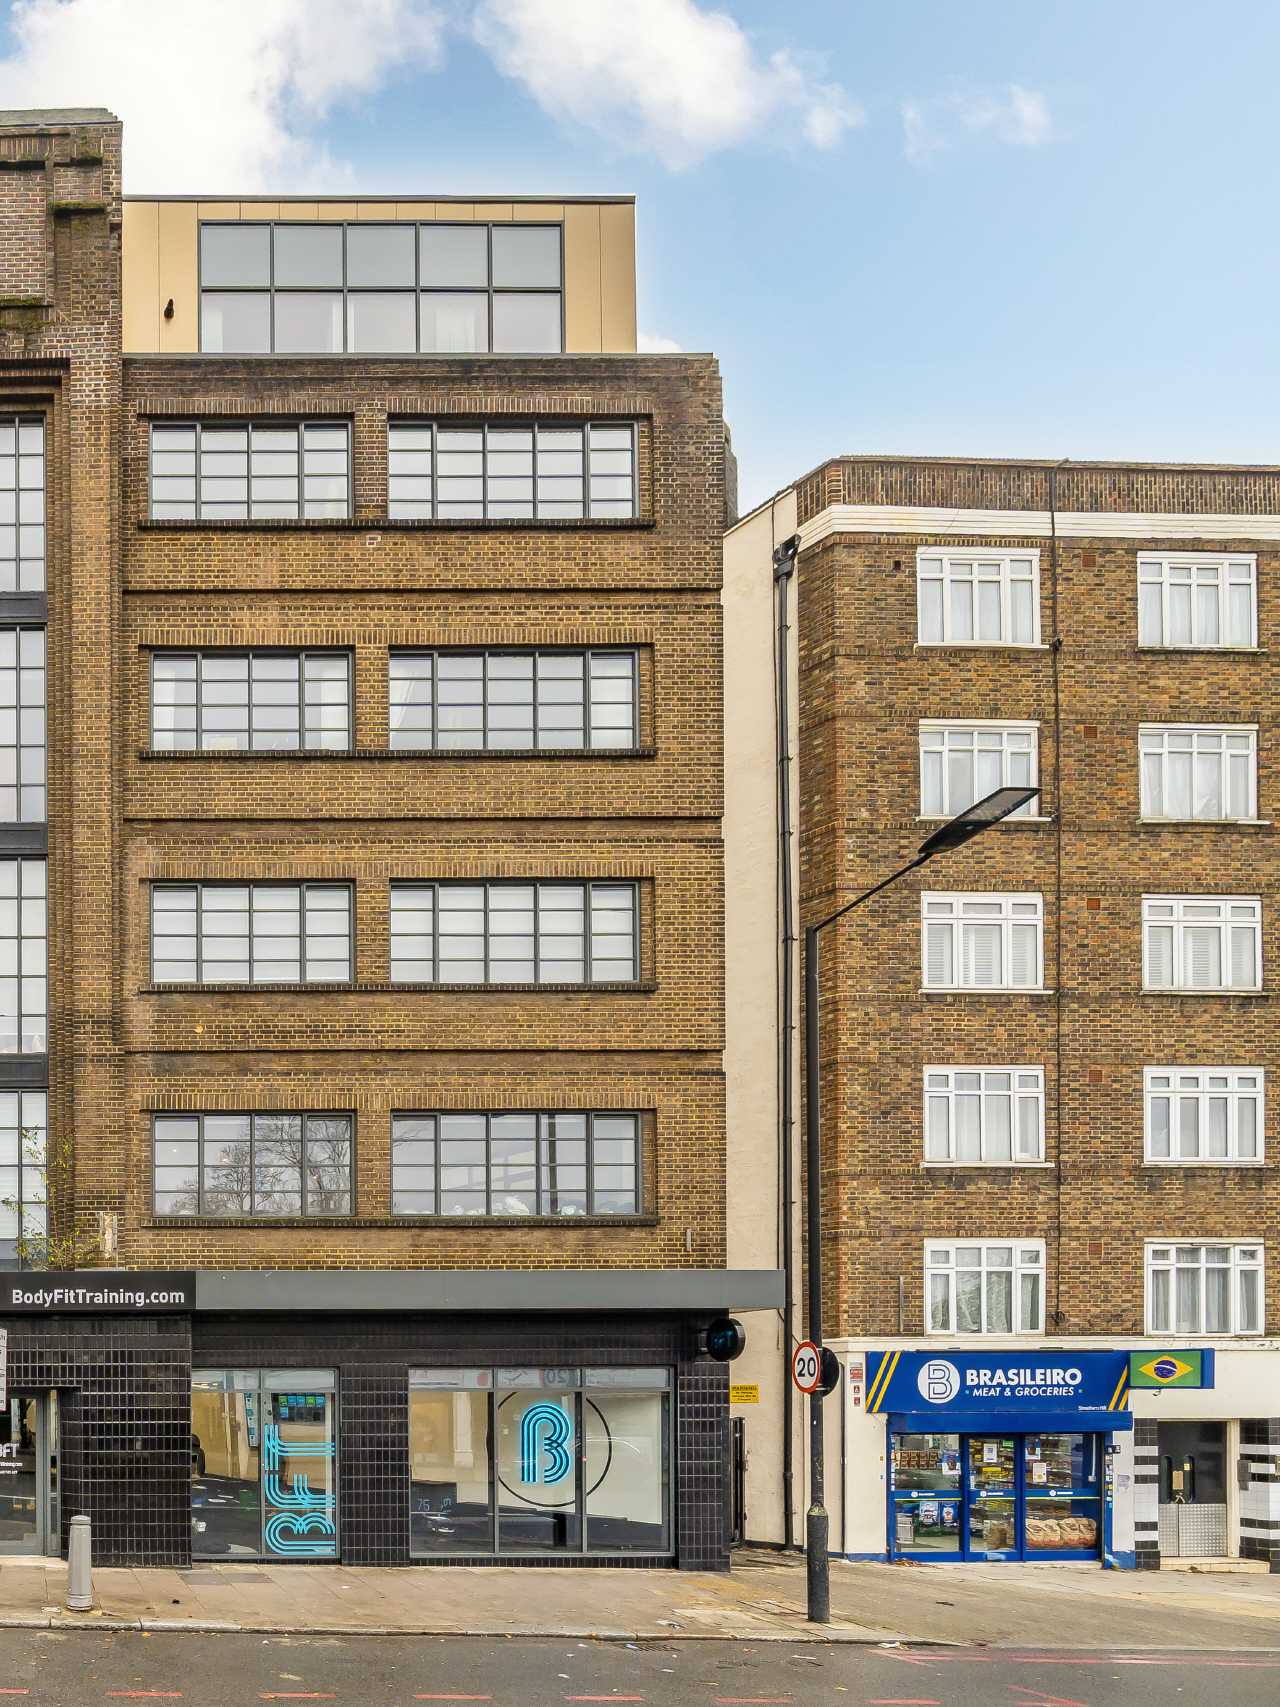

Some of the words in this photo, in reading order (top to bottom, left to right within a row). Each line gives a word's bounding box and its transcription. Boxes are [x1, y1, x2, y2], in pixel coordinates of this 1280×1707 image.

[12, 1289, 185, 1307] BodyFitTraining.com
[797, 1357, 816, 1377] 20
[966, 1368, 1082, 1386] BRASILEIRO
[972, 1387, 1000, 1397] MEAT
[1004, 1387, 1011, 1396] &
[1015, 1386, 1074, 1396] GROCERIES
[264, 1424, 336, 1556] BFT
